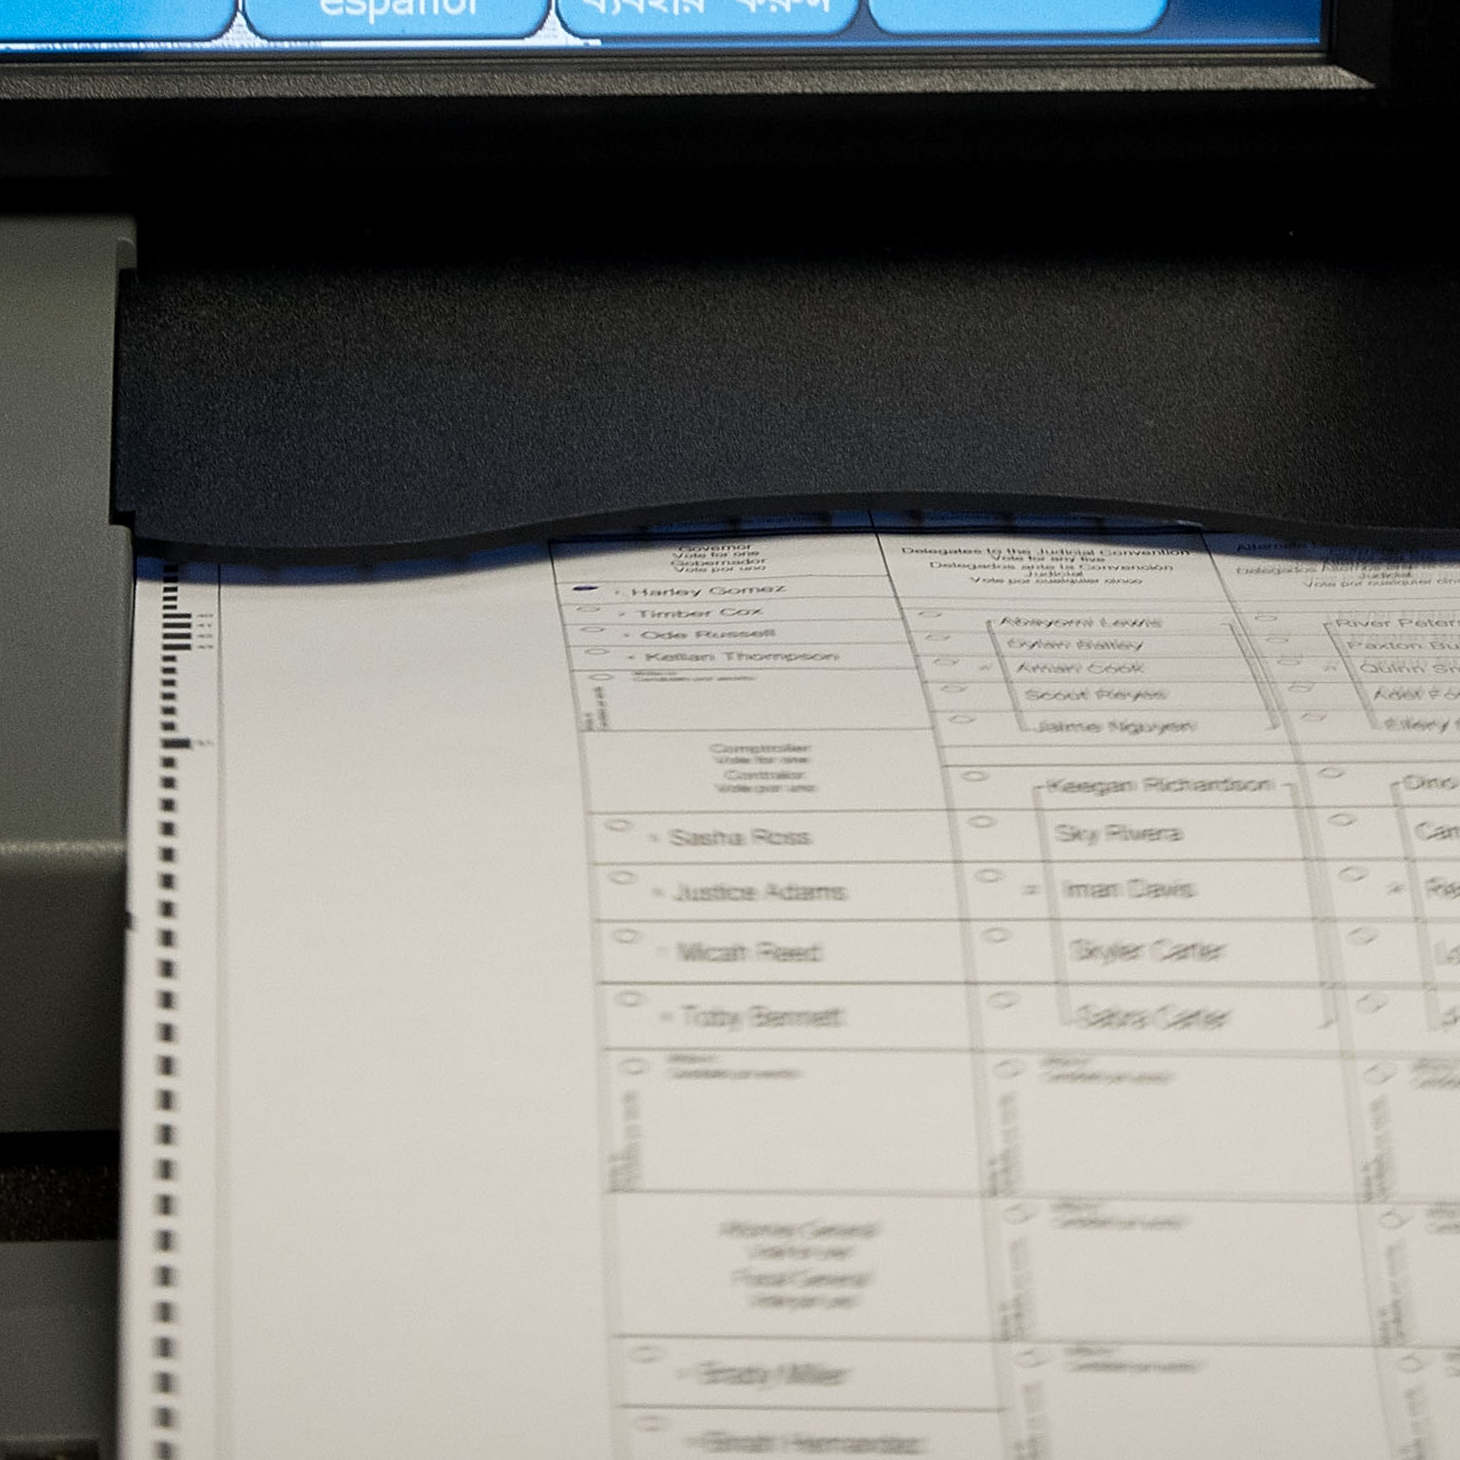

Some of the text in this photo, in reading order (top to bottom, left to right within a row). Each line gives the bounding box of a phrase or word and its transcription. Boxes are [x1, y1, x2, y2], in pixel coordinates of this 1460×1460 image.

[631, 583, 788, 598] Harley Gomez
[719, 606, 764, 617] Cox
[1335, 617, 1392, 628] River
[723, 650, 841, 663] Thompson
